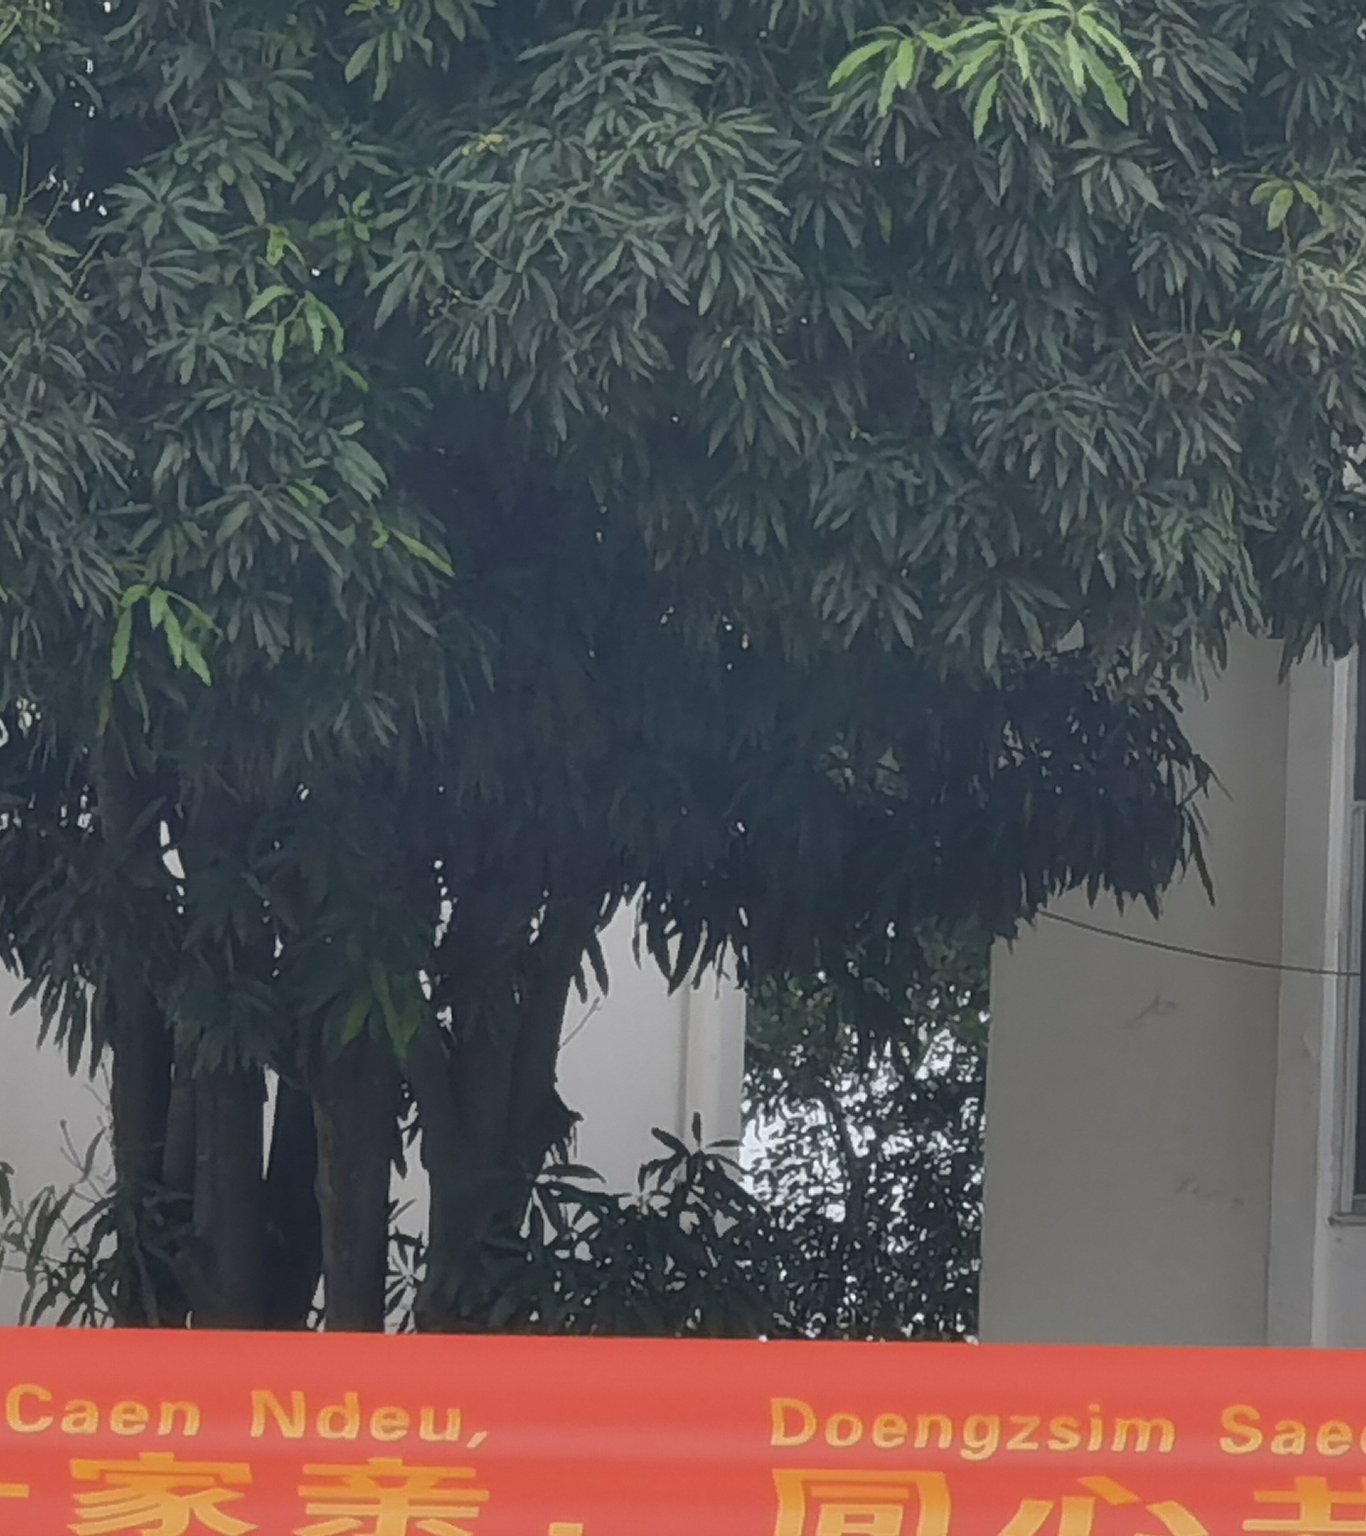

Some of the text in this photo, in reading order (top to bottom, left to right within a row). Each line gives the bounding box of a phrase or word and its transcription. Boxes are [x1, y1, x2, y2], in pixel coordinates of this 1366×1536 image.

[5, 1385, 202, 1436] Caen
[250, 1390, 488, 1449] Ndeu,
[770, 1398, 1176, 1460] Doengzsim
